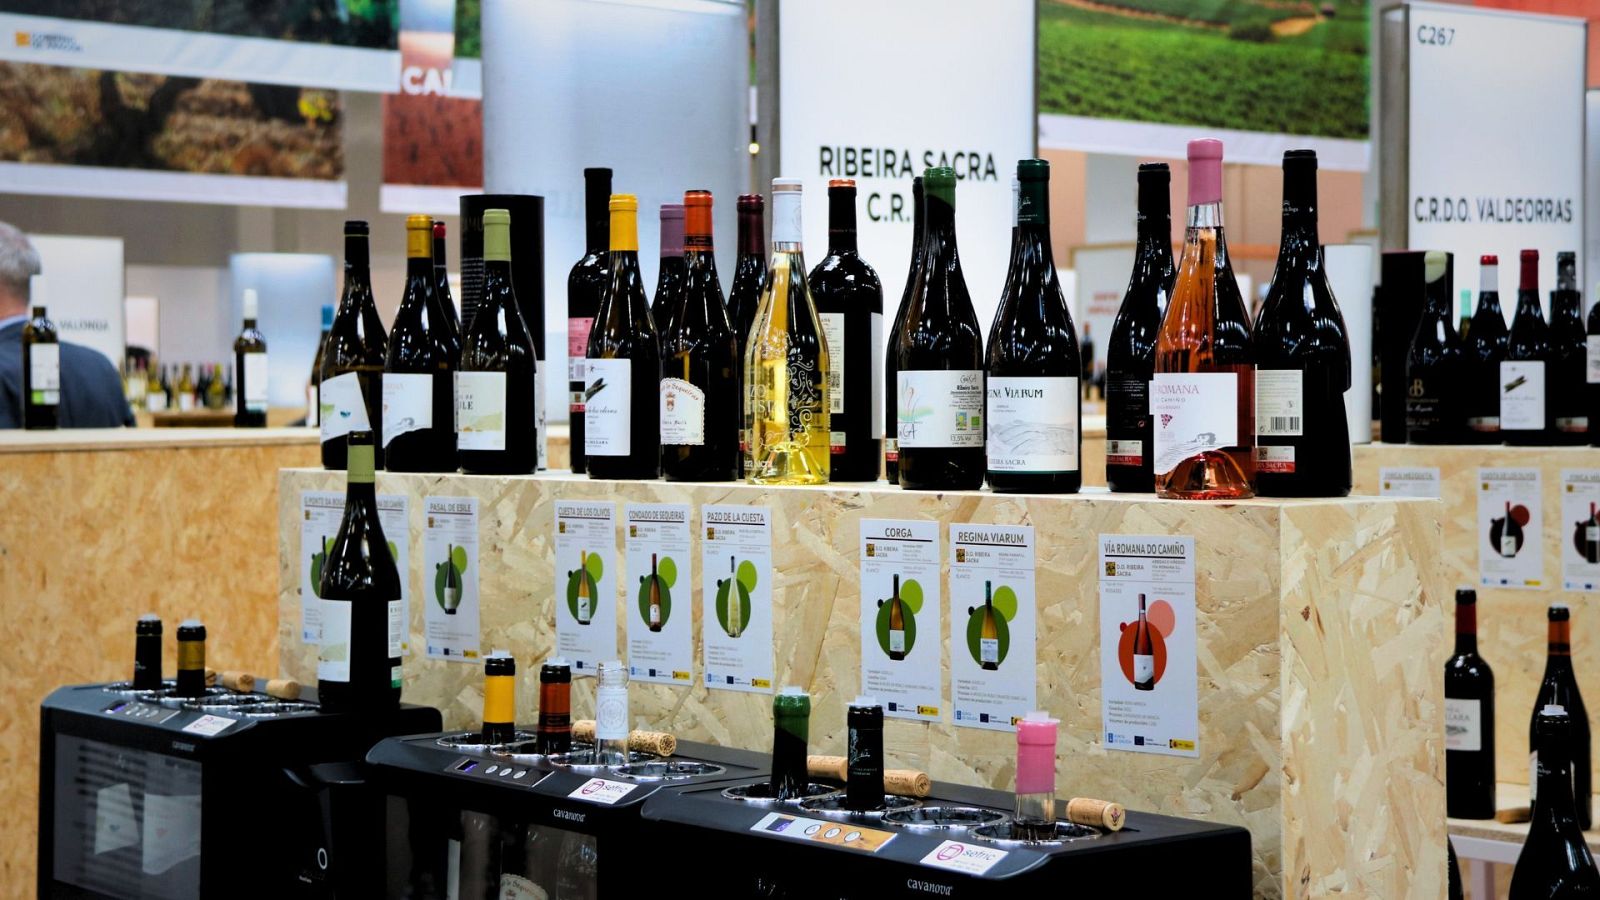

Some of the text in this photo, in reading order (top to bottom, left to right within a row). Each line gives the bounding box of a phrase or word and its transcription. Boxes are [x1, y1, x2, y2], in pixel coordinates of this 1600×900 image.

[1416, 25, 1455, 46] C267
[819, 146, 914, 178] RIBEIRA
[1415, 197, 1573, 224] C.R.D.O. VALDEORRAS
[1004, 386, 1043, 399] VIARUM
[558, 506, 576, 515] CUESTA
[584, 507, 593, 516] LOS
[628, 510, 652, 520] CONDADO
[659, 511, 685, 521] SEQUEIRAS
[707, 511, 765, 523] PAZO DE LA CUESTA
[885, 527, 912, 538] CORGA
[958, 531, 1025, 544] REGINA VIARUM
[1104, 540, 1185, 555] VÍA ROMANA DO CAMIÑO
[552, 808, 586, 823] cavanova
[907, 878, 951, 896] cavanova
